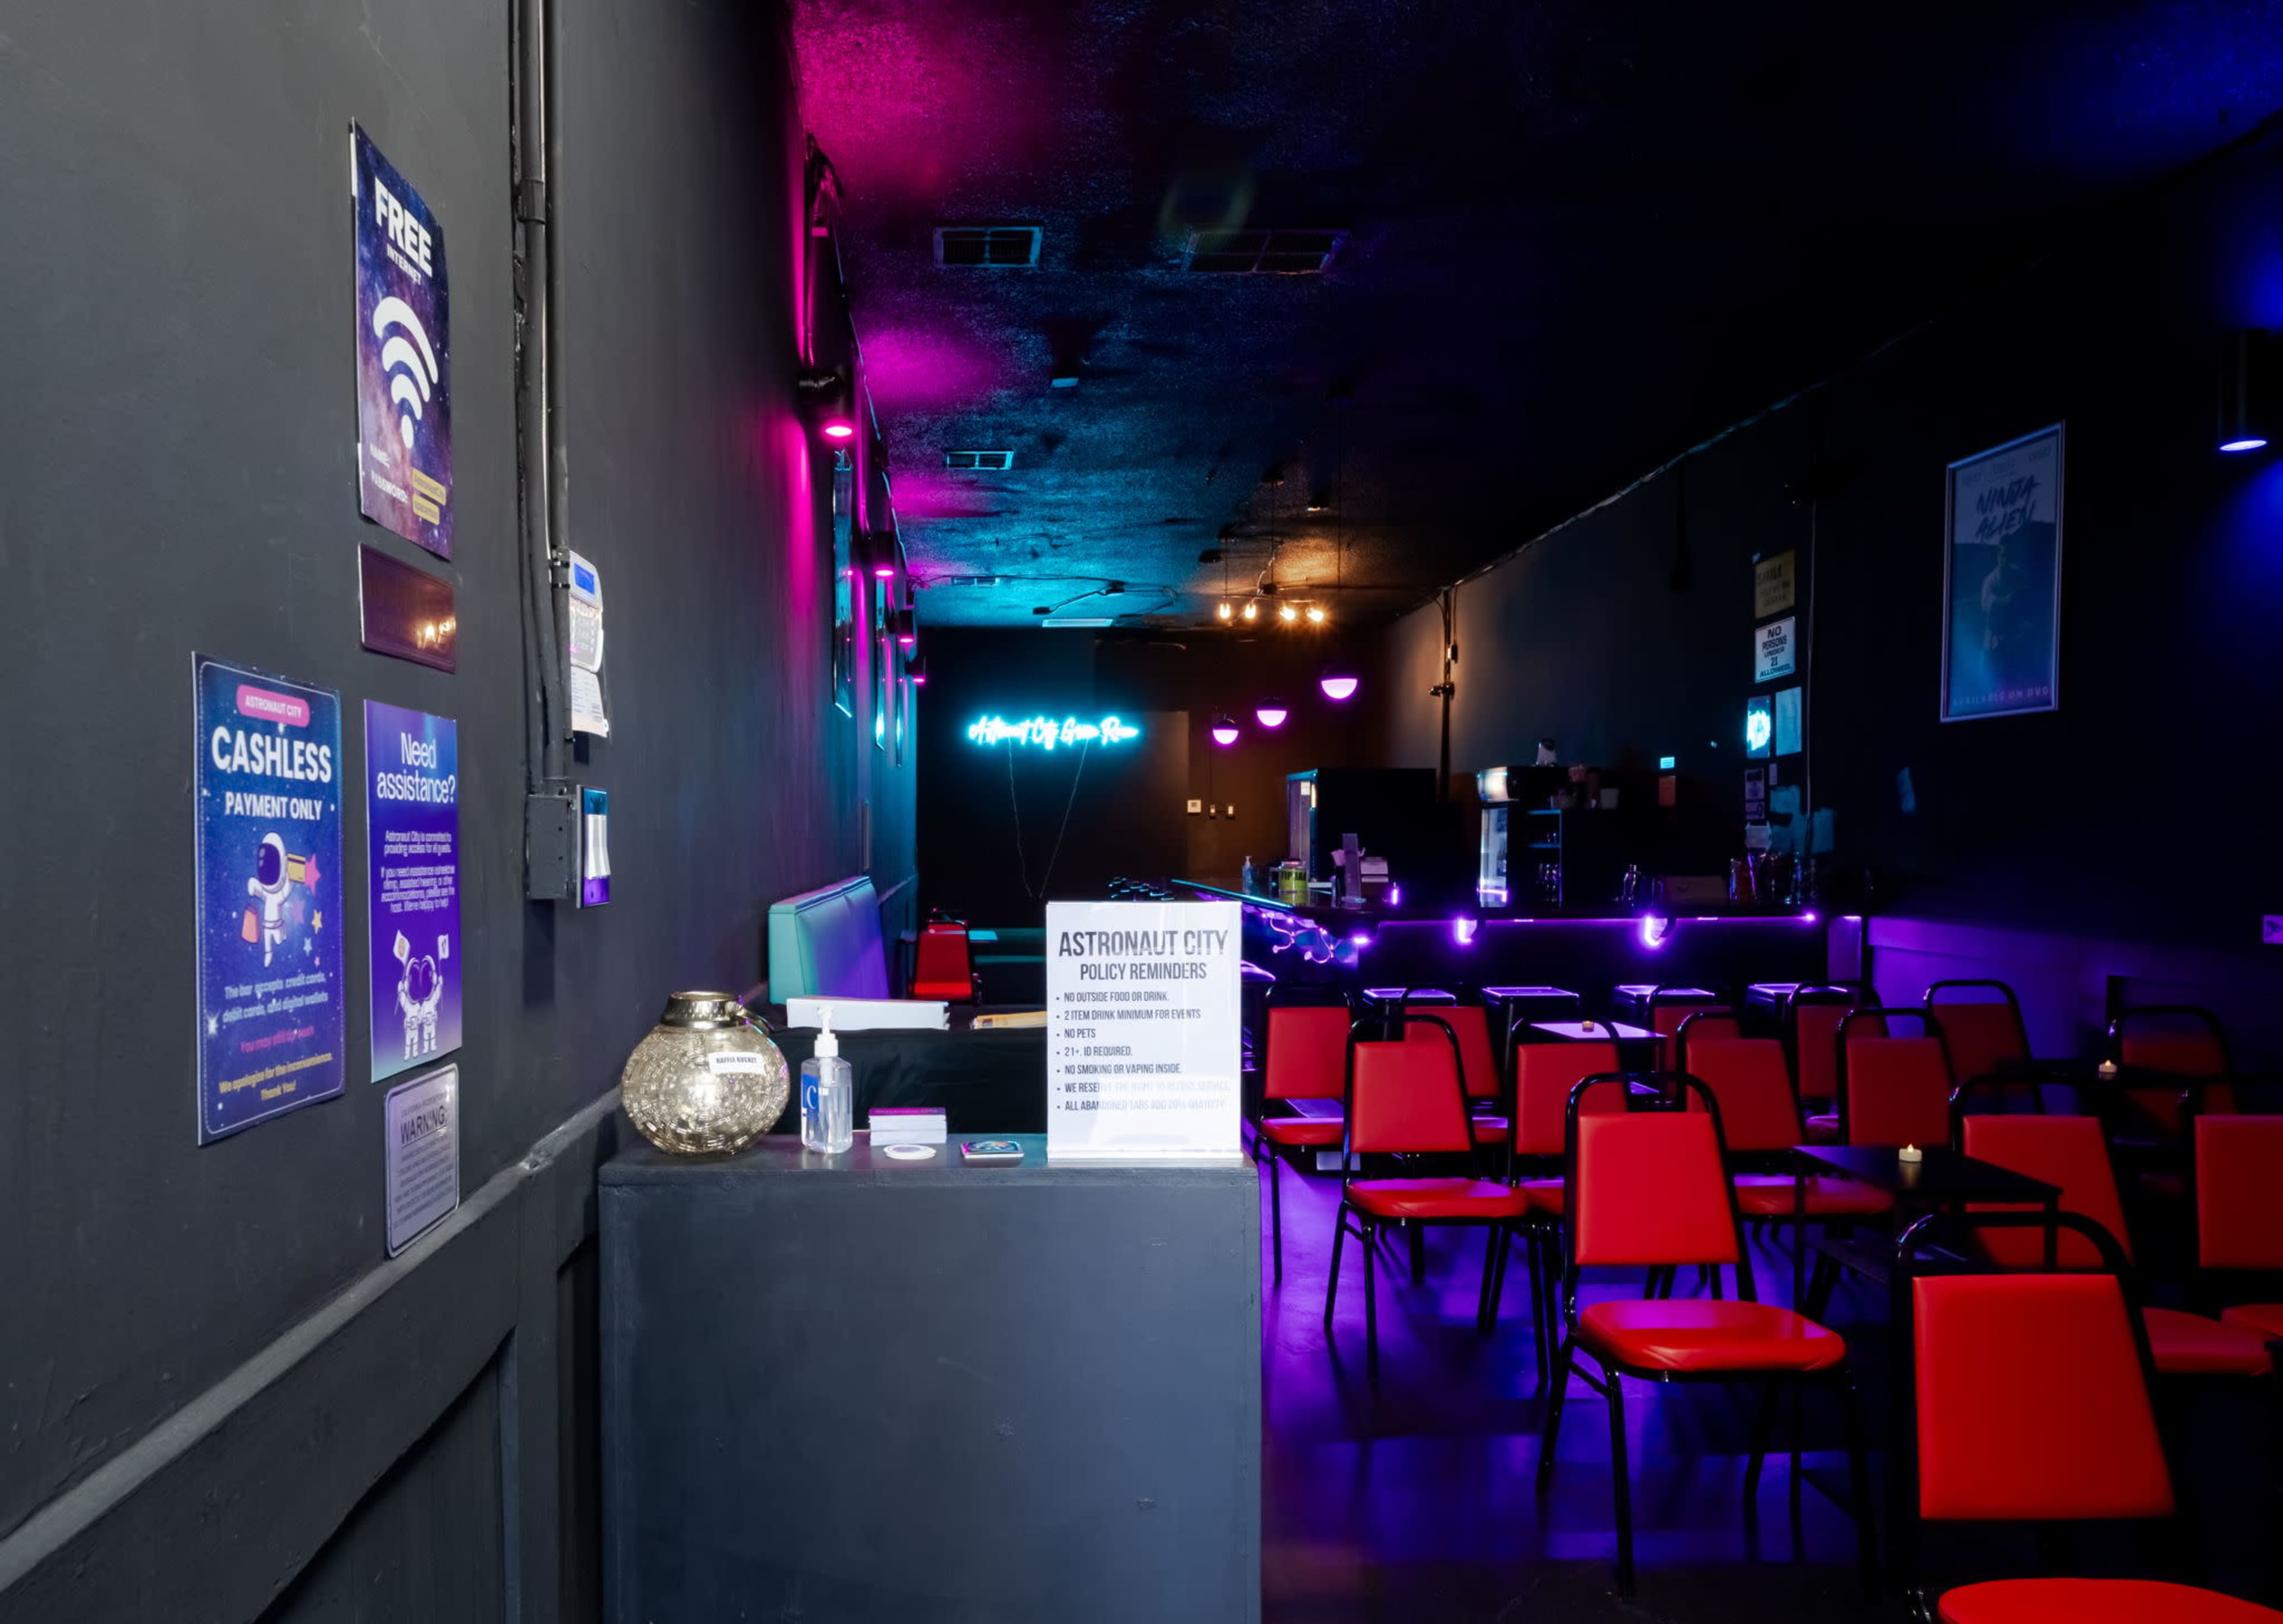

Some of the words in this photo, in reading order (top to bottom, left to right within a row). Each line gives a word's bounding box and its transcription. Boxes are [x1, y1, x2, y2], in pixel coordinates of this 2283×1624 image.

[375, 176, 433, 278] FREE
[387, 244, 422, 285] INTERNET
[1977, 476, 2040, 515] NINJA
[1975, 500, 2036, 545] ALIEN
[1768, 625, 1781, 639] NO
[1762, 634, 1787, 652] PERSONS
[1765, 646, 1785, 658] UNDER
[1760, 663, 1790, 678] ALLOWED
[1771, 656, 1778, 667] 21
[2008, 690, 2024, 700] ON
[2027, 687, 2049, 697] DVD
[245, 695, 287, 715] ASTRONAUT
[286, 705, 302, 719] CITY
[212, 726, 332, 783] CASHLESS
[401, 731, 436, 769] Need
[377, 769, 456, 804] assistance?
[225, 791, 288, 819] PAYMENT
[290, 797, 323, 821] ONLY
[1058, 930, 1178, 957] ASTRONAUT
[1183, 930, 1229, 956] CITY
[1080, 963, 1126, 981] POLICY
[1130, 962, 1207, 980] REMINDERS
[224, 984, 239, 999] The
[239, 983, 253, 997] bar
[254, 978, 284, 995] accepts
[285, 972, 306, 989] credit
[1064, 992, 1075, 1003] NO
[1076, 991, 1108, 1003] OUTSIDE
[1109, 991, 1130, 1002] FOOD
[1131, 991, 1143, 1002] OR
[1144, 990, 1169, 1002] DRINK.
[222, 1006, 243, 1023] debit
[267, 998, 282, 1014] and
[282, 994, 304, 1013] digital
[304, 991, 329, 1005] wallets
[1064, 1011, 1070, 1021] 2
[1071, 1010, 1090, 1021] ITEM
[1092, 1010, 1115, 1021] DRINK
[1117, 1009, 1153, 1020] MINIMUM
[1155, 1009, 1170, 1020] FOR
[1171, 1009, 1202, 1019] EVENTS
[1064, 1028, 1076, 1038] NO
[1077, 1028, 1096, 1038] PETS
[1084, 1046, 1092, 1057] ID
[1093, 1046, 1133, 1057] REQUIRED.
[1065, 1065, 1077, 1075] NO
[1077, 1064, 1112, 1075] SMOKING
[1114, 1064, 1124, 1075] OR
[1125, 1063, 1155, 1074] VAPING
[1155, 1063, 1183, 1074] INSIDE.
[219, 1081, 232, 1094] We
[265, 1066, 275, 1079] for
[275, 1064, 287, 1077] the
[1065, 1082, 1077, 1093] WE
[260, 1084, 281, 1100] Thank
[1065, 1100, 1079, 1111] ALL
[400, 1104, 445, 1144] WARNING
